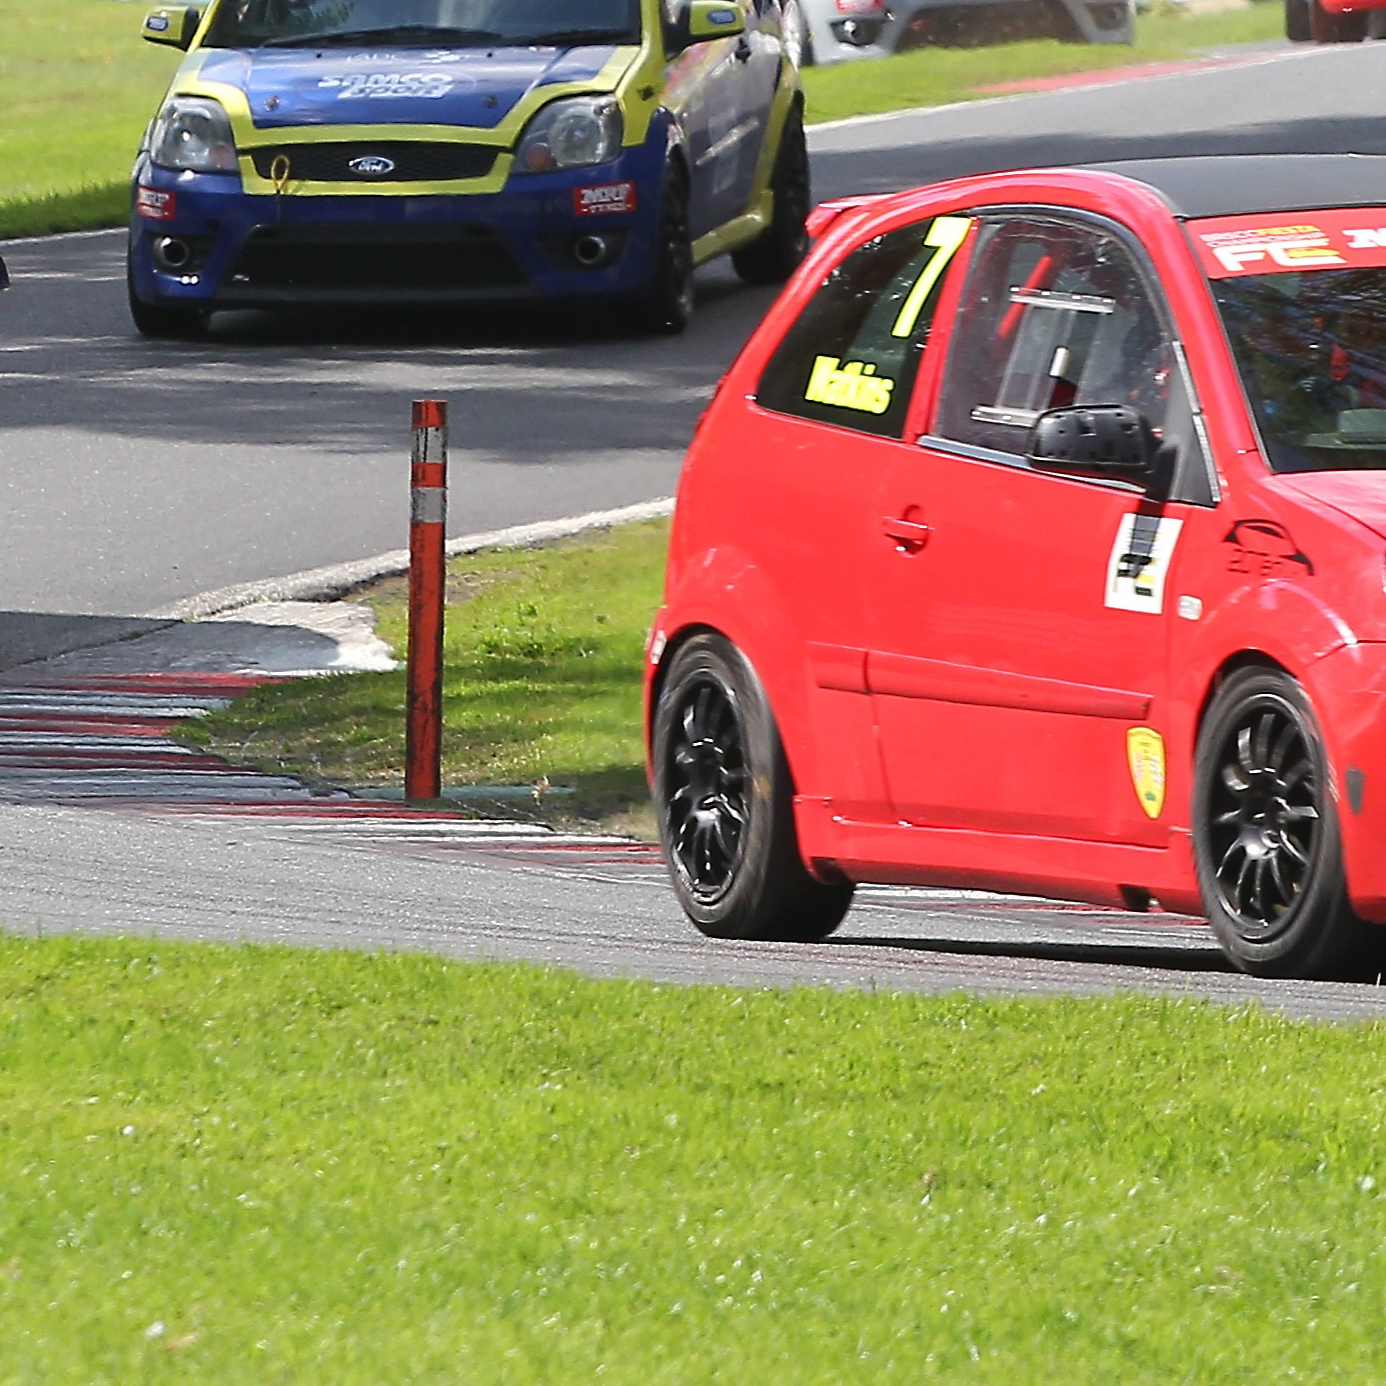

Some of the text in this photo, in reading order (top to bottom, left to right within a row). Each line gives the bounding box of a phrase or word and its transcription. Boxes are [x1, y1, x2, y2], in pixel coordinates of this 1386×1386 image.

[891, 216, 972, 338] 7
[1212, 238, 1349, 271] FC
[804, 355, 895, 414] Watkins
